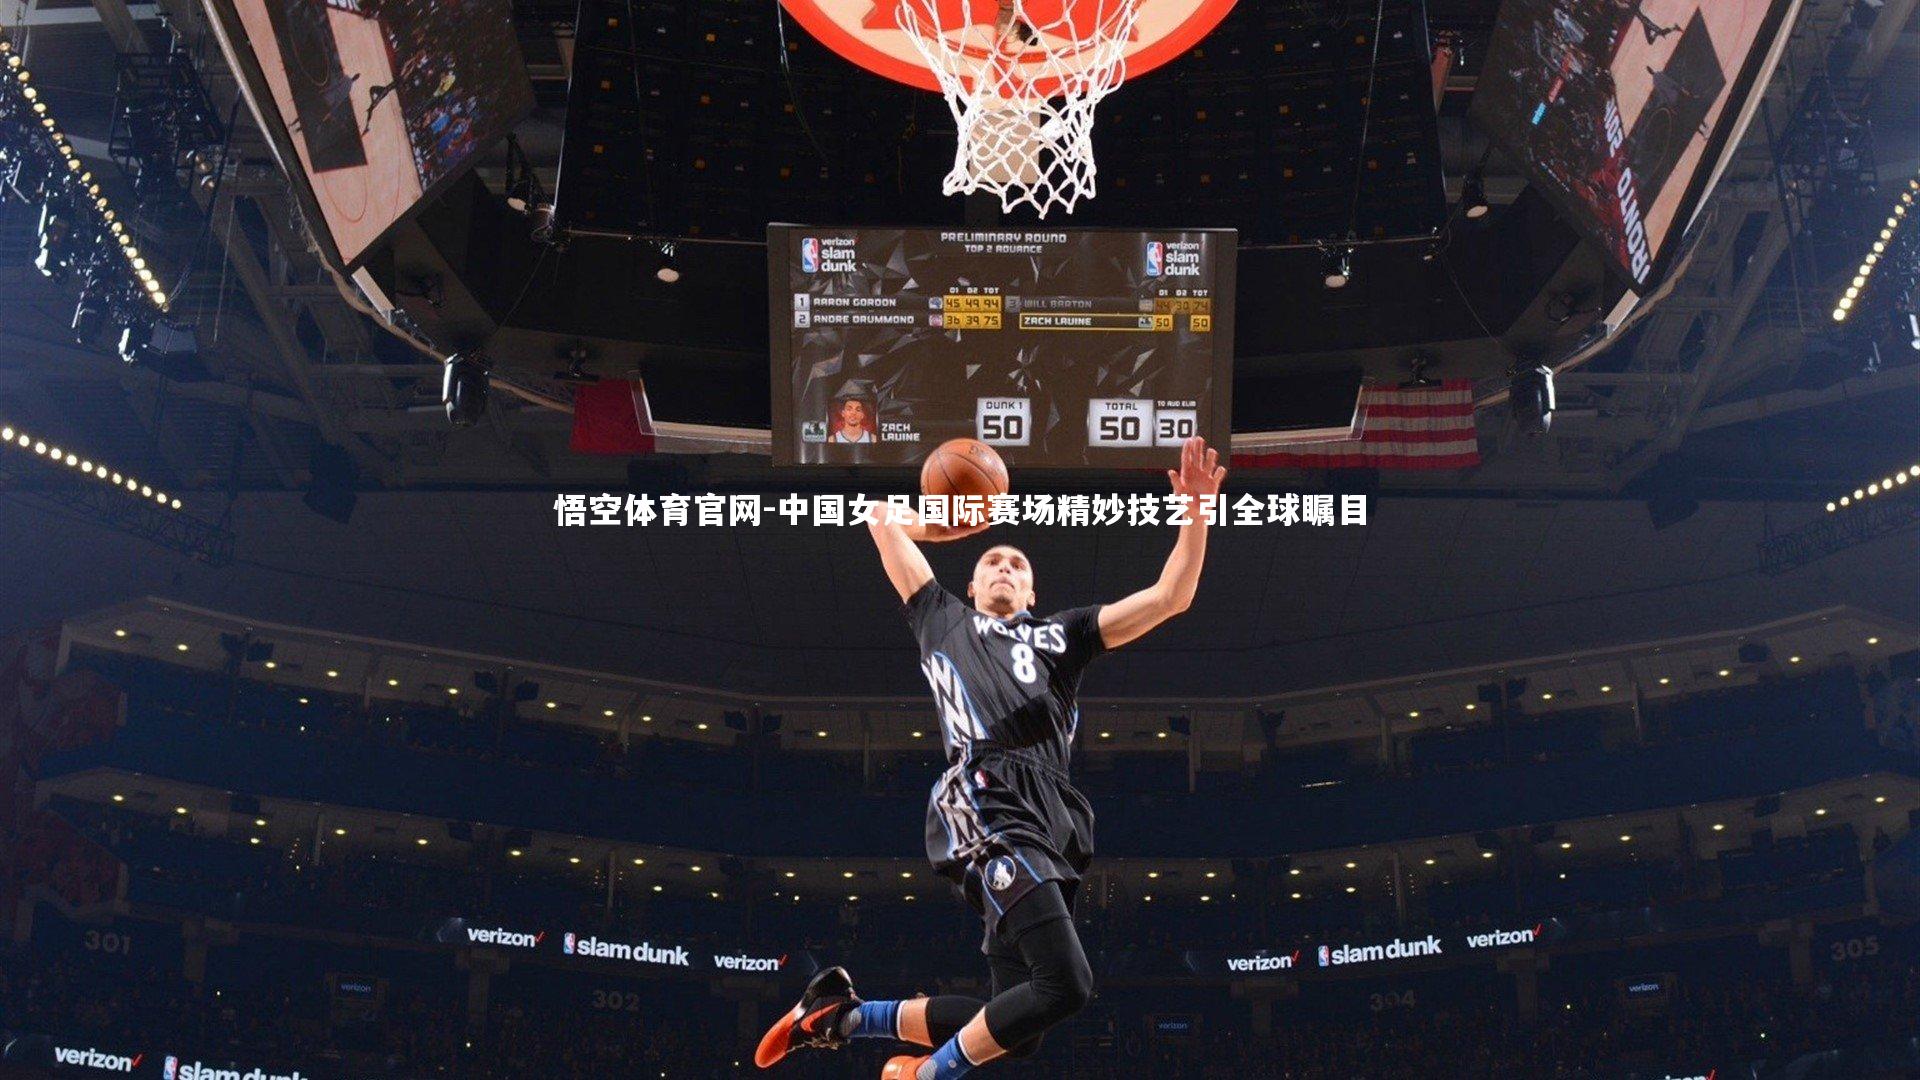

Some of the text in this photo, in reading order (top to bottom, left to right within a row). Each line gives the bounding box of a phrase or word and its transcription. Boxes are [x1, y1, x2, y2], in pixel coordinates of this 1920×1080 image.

[821, 237, 854, 246] verizon
[941, 232, 1067, 243] PRELIMINARY ROUND
[965, 244, 984, 253] TOP
[986, 245, 993, 253] 2
[1166, 241, 1199, 250] verizon
[821, 246, 855, 259] slam
[1166, 250, 1199, 263] slam
[821, 259, 857, 272] dunk
[1165, 263, 1200, 276] dunk
[813, 298, 850, 306] AARON
[853, 298, 897, 307] GORDON
[946, 299, 961, 308] 45
[965, 299, 979, 308] 49
[984, 299, 999, 308] 94
[1024, 300, 1047, 308] WILL
[1050, 300, 1092, 308] BARTON
[799, 315, 999, 325] 2 ANDRE DRUMMOND 36 39 75
[1024, 316, 1052, 325] ZACH
[1156, 318, 1170, 327] 50
[1193, 318, 1208, 327] 50
[985, 401, 1015, 409] DUNK
[1105, 402, 1138, 411] TOTAL
[881, 422, 911, 432] ZACH
[982, 415, 1023, 440] 50
[1100, 416, 1140, 441] 50
[1159, 418, 1193, 438] 30
[973, 615, 1067, 653] WOLVES
[1011, 643, 1037, 683] 8
[84, 929, 132, 955] 301
[467, 927, 536, 948] verizon
[1466, 928, 1535, 949] verizon
[576, 935, 689, 967] slam dunk
[1331, 934, 1443, 966] slam dunk
[1830, 935, 1881, 962] 305
[714, 953, 780, 971] verizon
[1227, 953, 1293, 972] verizon
[340, 982, 371, 994] verizon
[1629, 982, 1660, 993] verizon
[592, 989, 640, 1013] 302
[1158, 1021, 1188, 1031] verizon
[55, 1046, 133, 1073] verizon
[178, 1061, 240, 1080] slam
